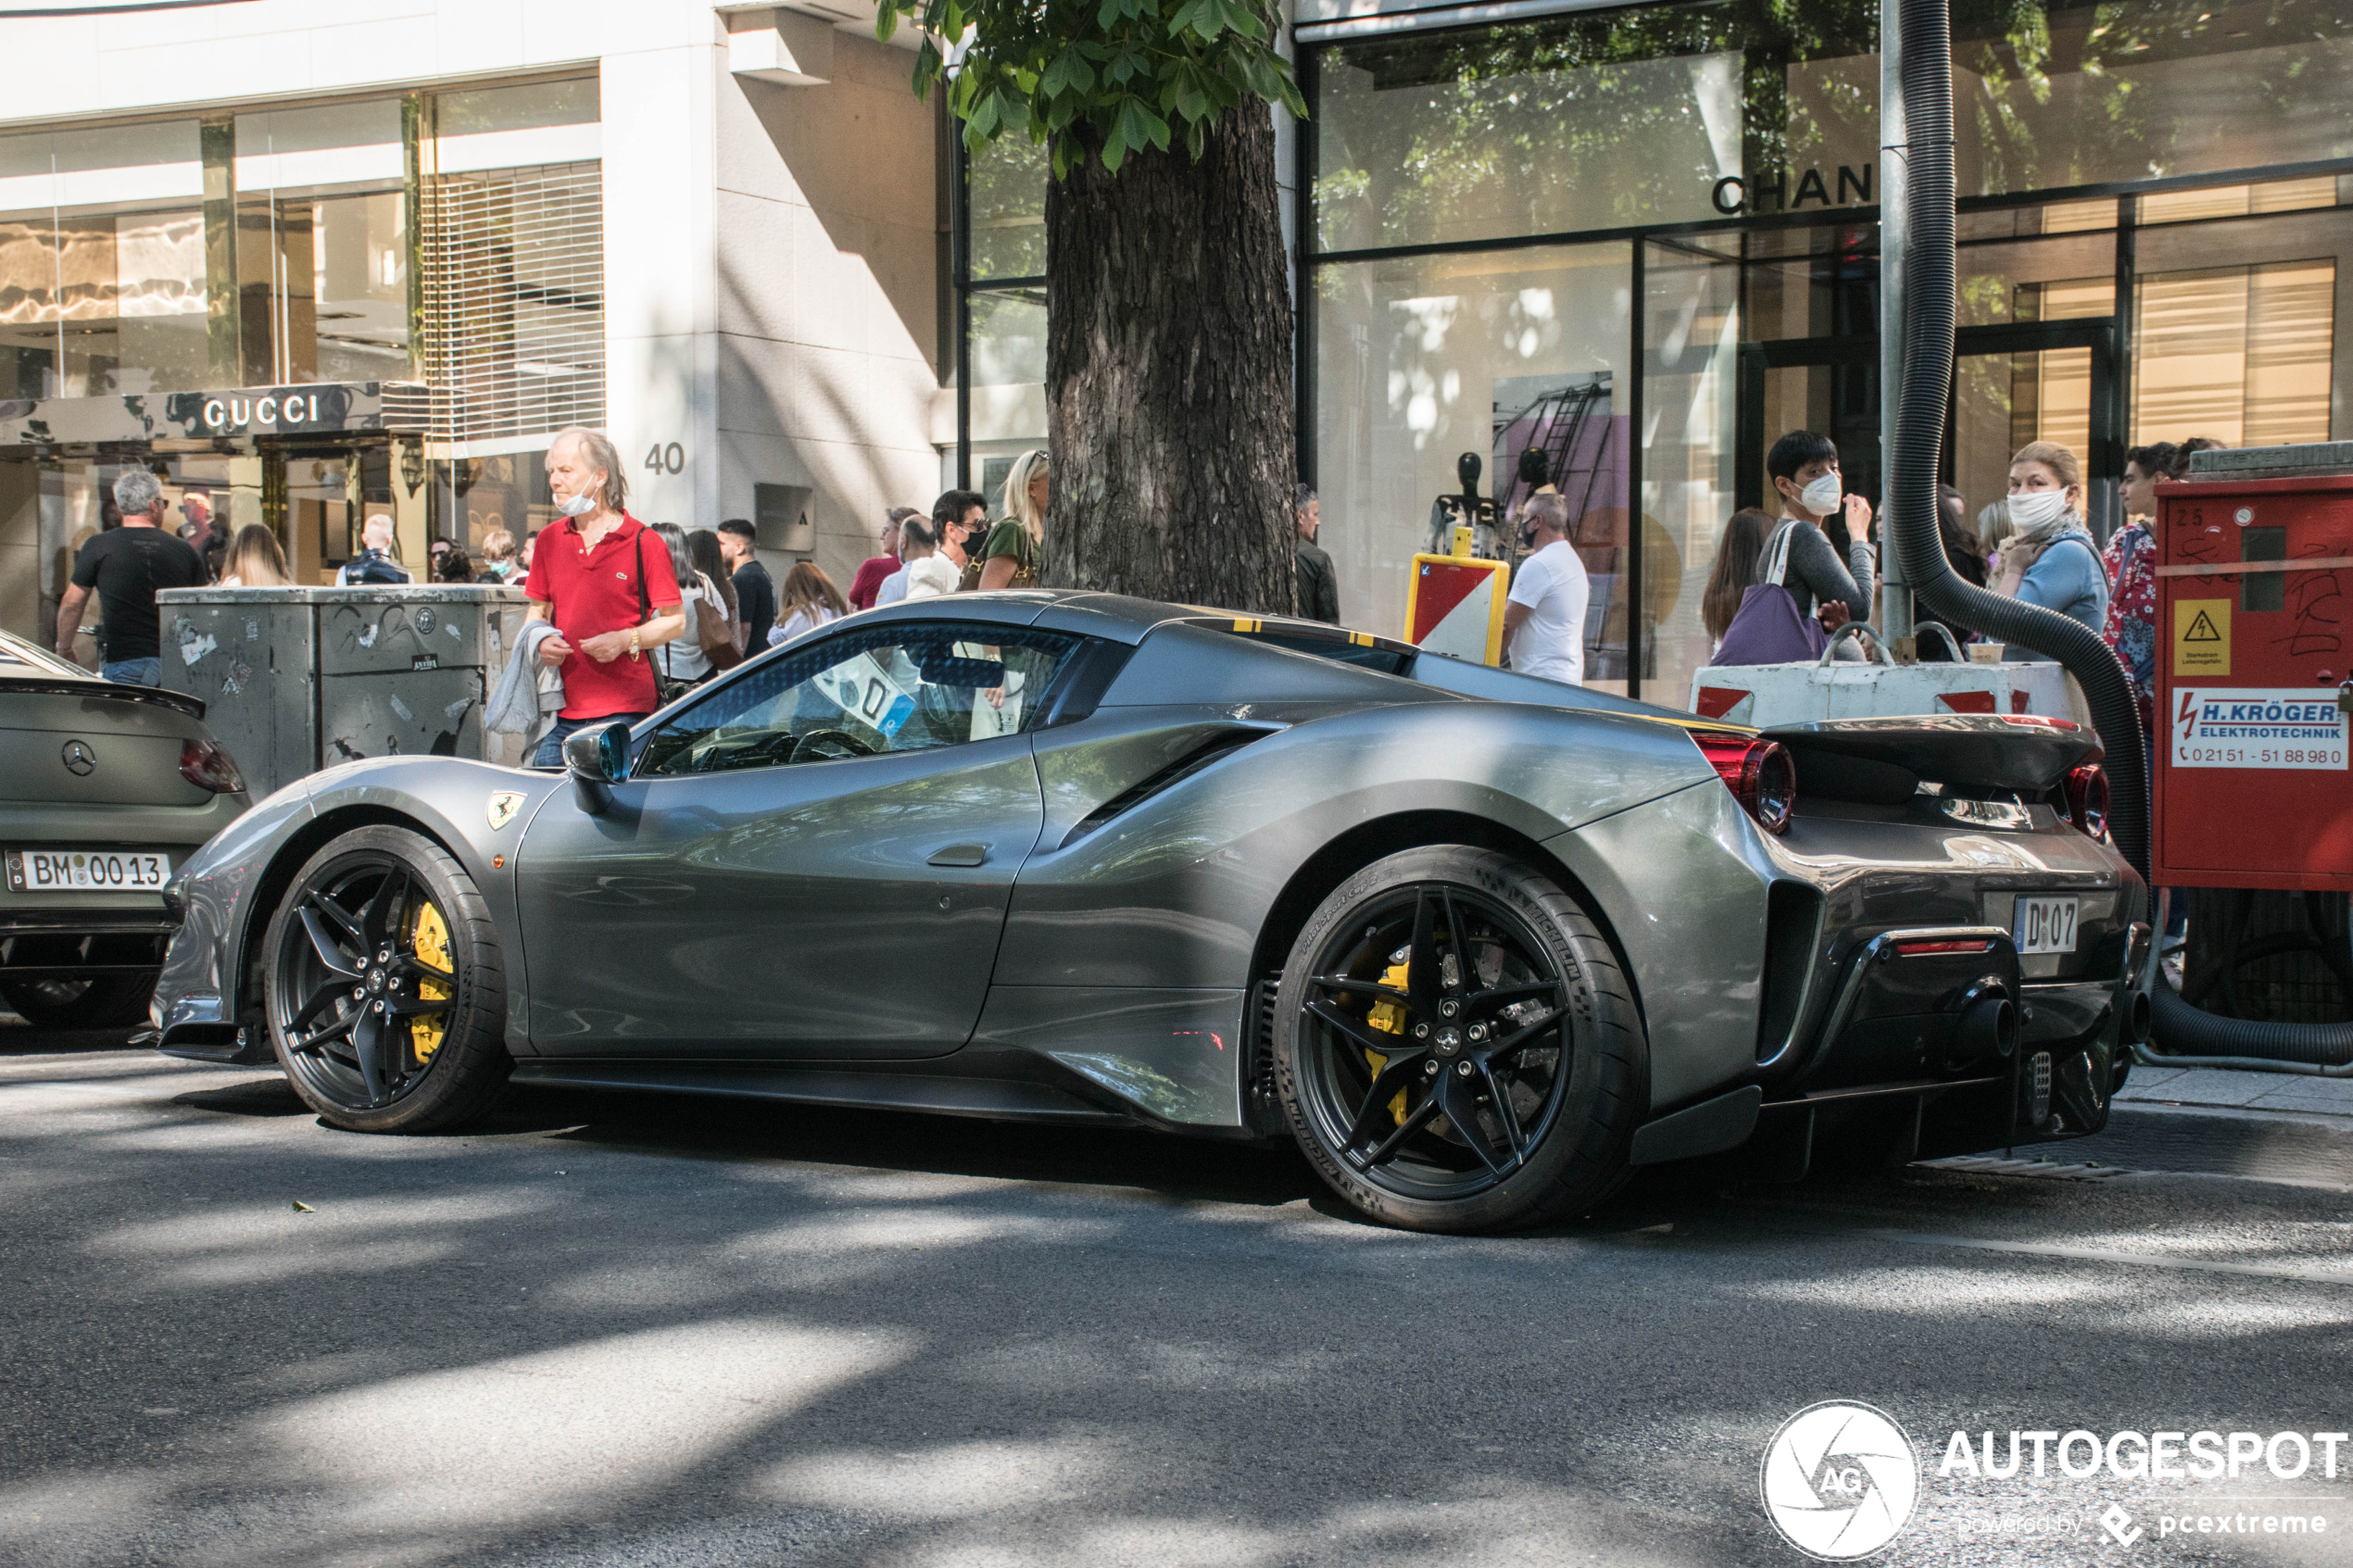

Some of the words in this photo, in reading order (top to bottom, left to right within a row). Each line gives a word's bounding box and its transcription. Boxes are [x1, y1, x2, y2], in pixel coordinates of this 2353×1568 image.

[1712, 163, 1871, 215] CHAN
[204, 395, 318, 427] GUCCI
[645, 442, 685, 475] 40
[2200, 727, 2342, 739] ELEKTROTECHNIK
[14, 875, 22, 884] D
[33, 855, 72, 884] BM
[1301, 922, 1322, 955] Pilot
[1320, 893, 1348, 926] Sport
[1346, 879, 1368, 898] Cup
[2028, 903, 2040, 947] D
[1528, 900, 1581, 983] MICHELIN
[1287, 1098, 1339, 1178] MICHELIN
